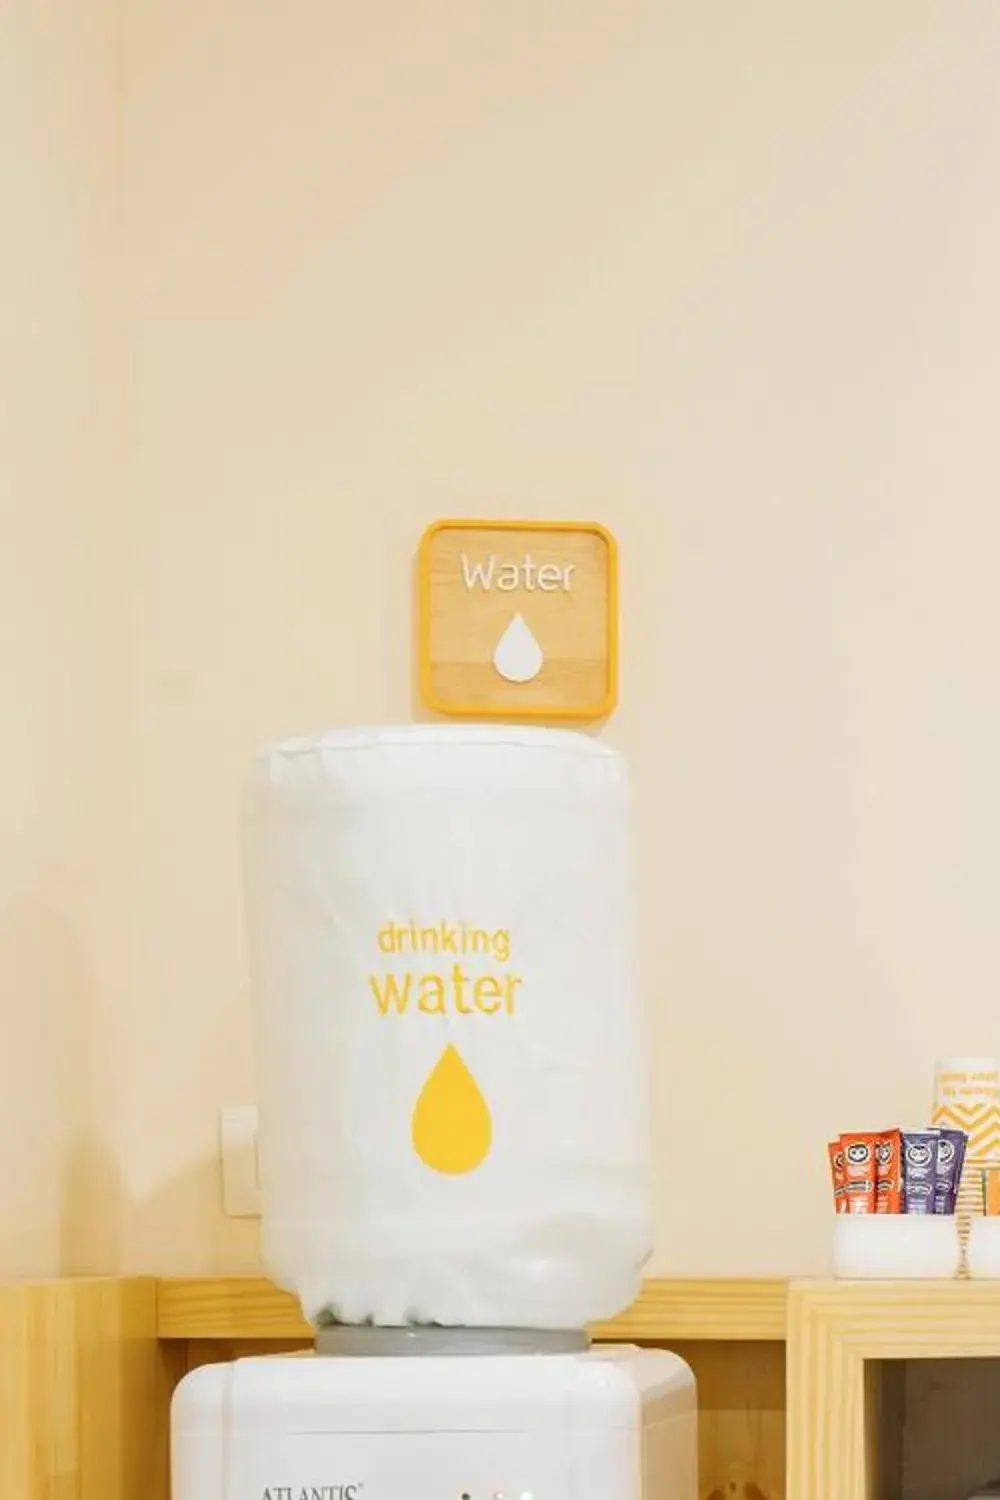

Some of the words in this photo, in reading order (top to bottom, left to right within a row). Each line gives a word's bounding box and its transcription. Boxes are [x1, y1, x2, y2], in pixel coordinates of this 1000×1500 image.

[461, 552, 576, 592] Water
[377, 919, 511, 963] drinking
[369, 963, 522, 1016] water
